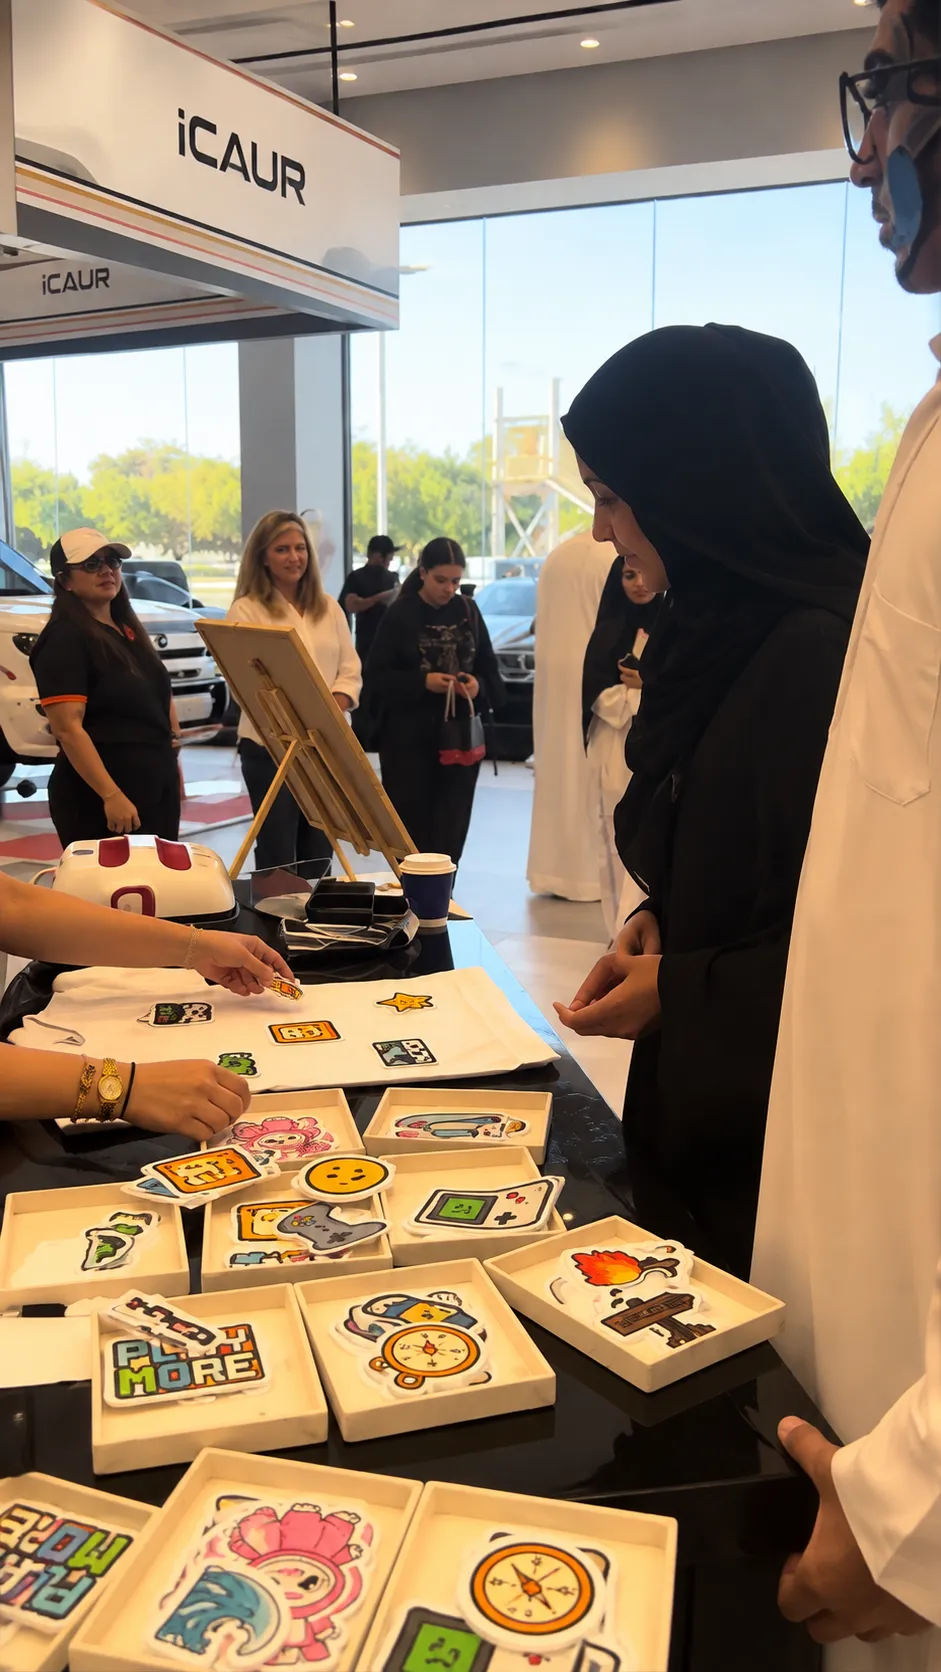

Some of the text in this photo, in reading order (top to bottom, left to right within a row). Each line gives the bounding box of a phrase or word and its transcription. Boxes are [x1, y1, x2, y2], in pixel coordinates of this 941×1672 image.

[178, 108, 306, 205] iCAUR
[42, 267, 110, 295] iCAUR
[116, 1328, 248, 1367] PLY
[117, 1352, 257, 1397] MORE
